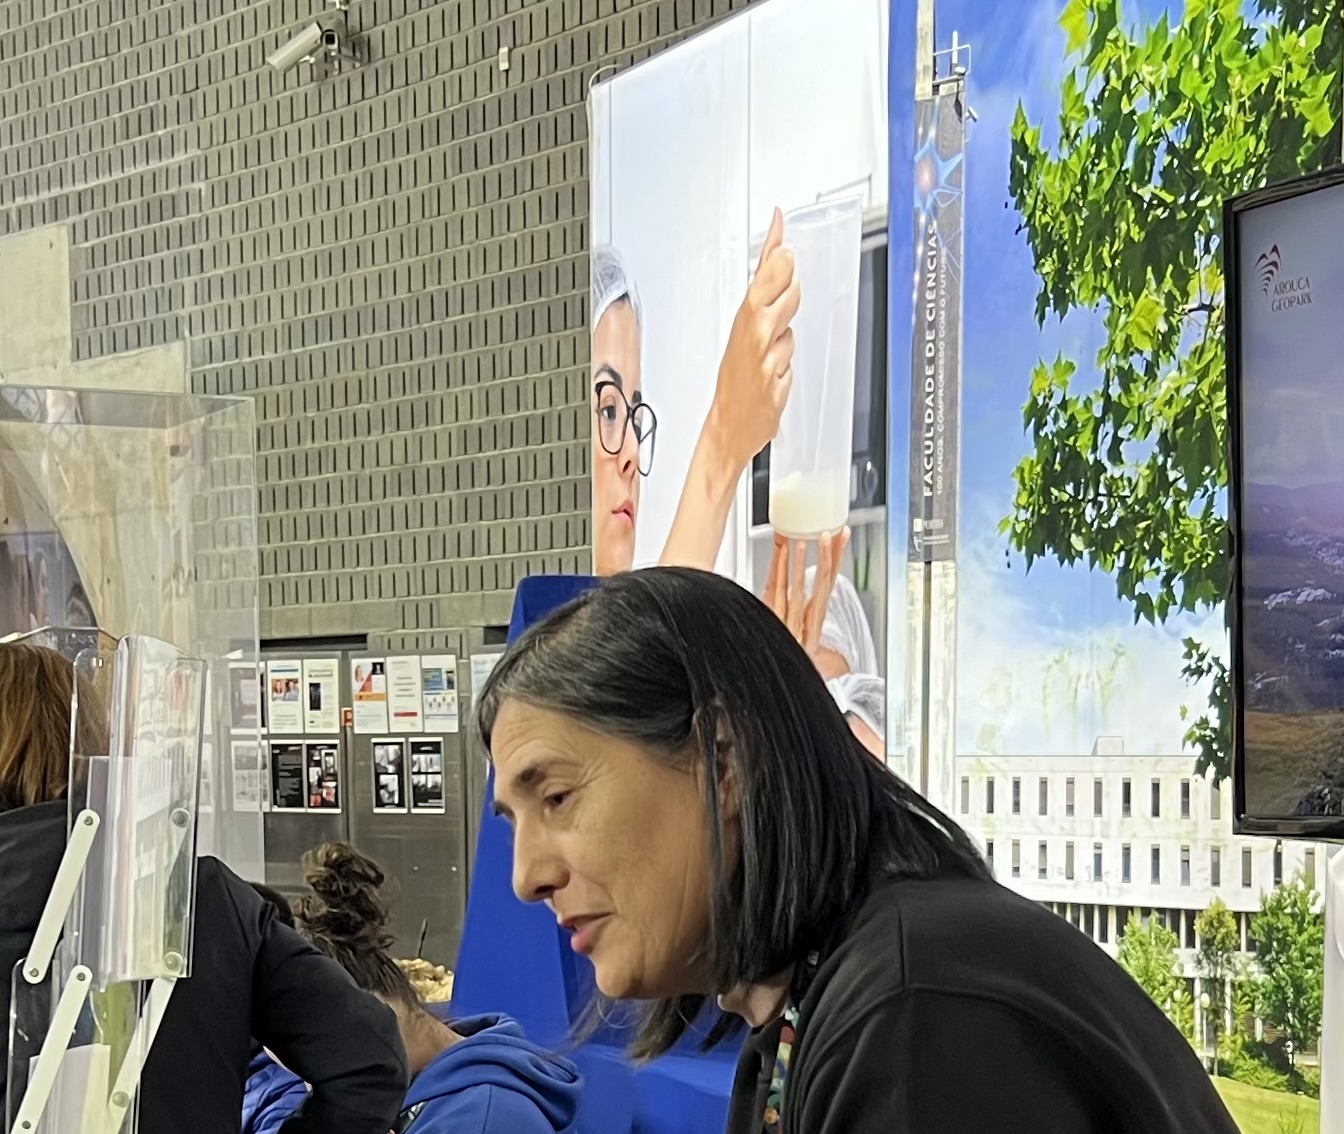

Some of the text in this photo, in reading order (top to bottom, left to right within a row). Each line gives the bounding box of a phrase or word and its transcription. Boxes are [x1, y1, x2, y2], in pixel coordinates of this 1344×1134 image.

[1271, 292, 1313, 313] GEOPARK
[938, 310, 946, 338] COM
[922, 220, 937, 497] FACULDADE DE CIÊNCIAS
